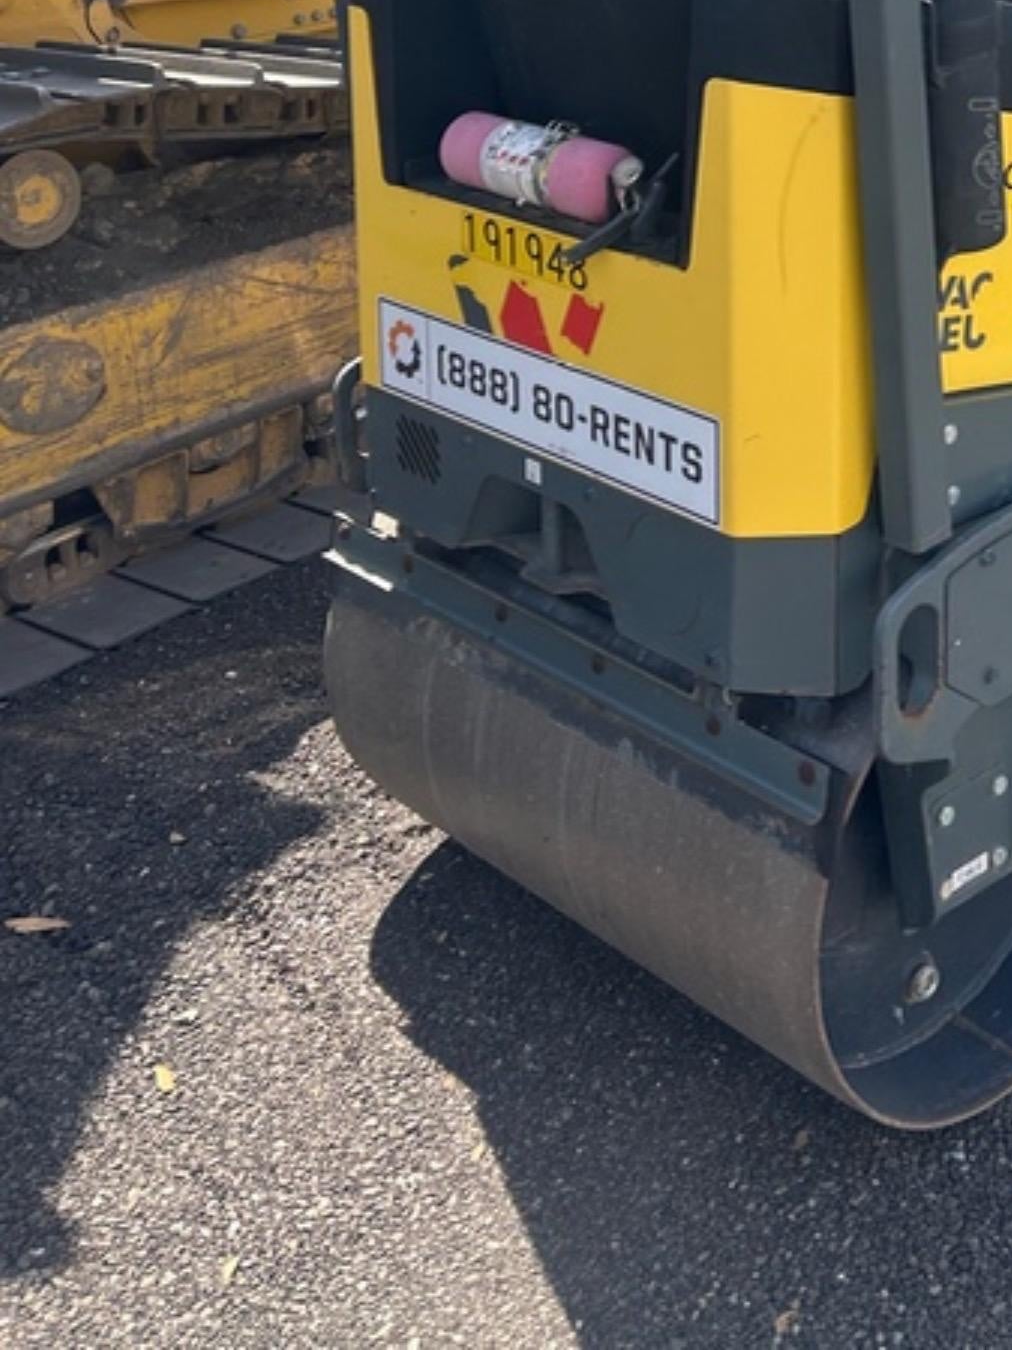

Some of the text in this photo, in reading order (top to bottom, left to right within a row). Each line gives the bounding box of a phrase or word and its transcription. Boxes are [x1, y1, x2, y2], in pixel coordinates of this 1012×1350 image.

[464, 212, 588, 291] 191948
[436, 343, 704, 484] (888) 80-RENTS
